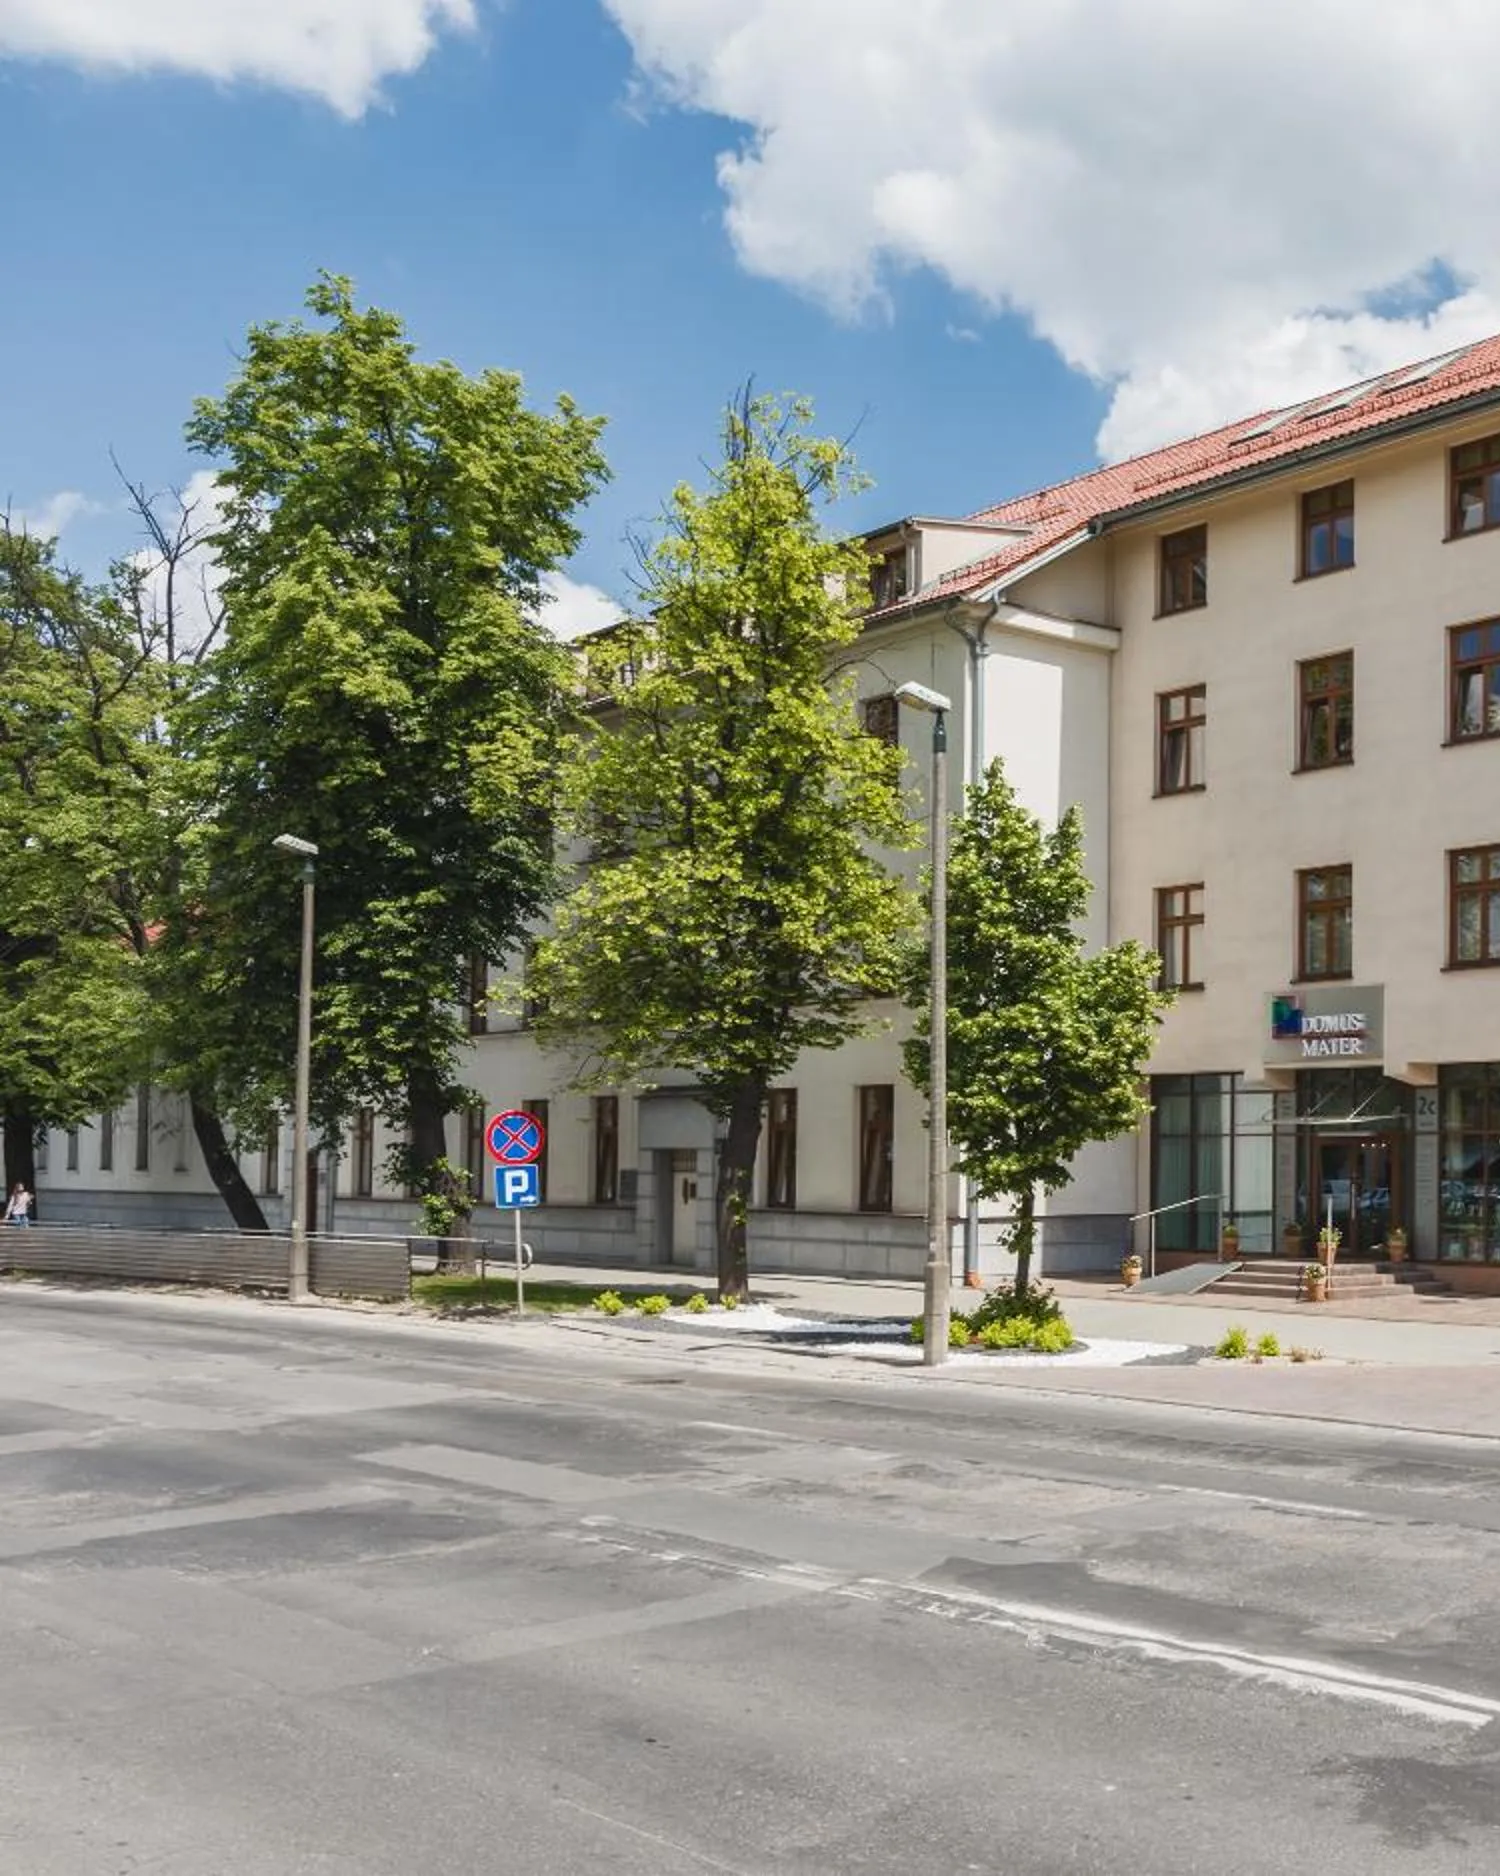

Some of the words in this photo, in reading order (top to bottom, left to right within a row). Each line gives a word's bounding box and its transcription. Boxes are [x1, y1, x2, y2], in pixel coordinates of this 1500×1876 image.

[1302, 1013, 1366, 1033] DOMUS
[1302, 1037, 1363, 1057] MATER
[504, 1169, 529, 1203] P
